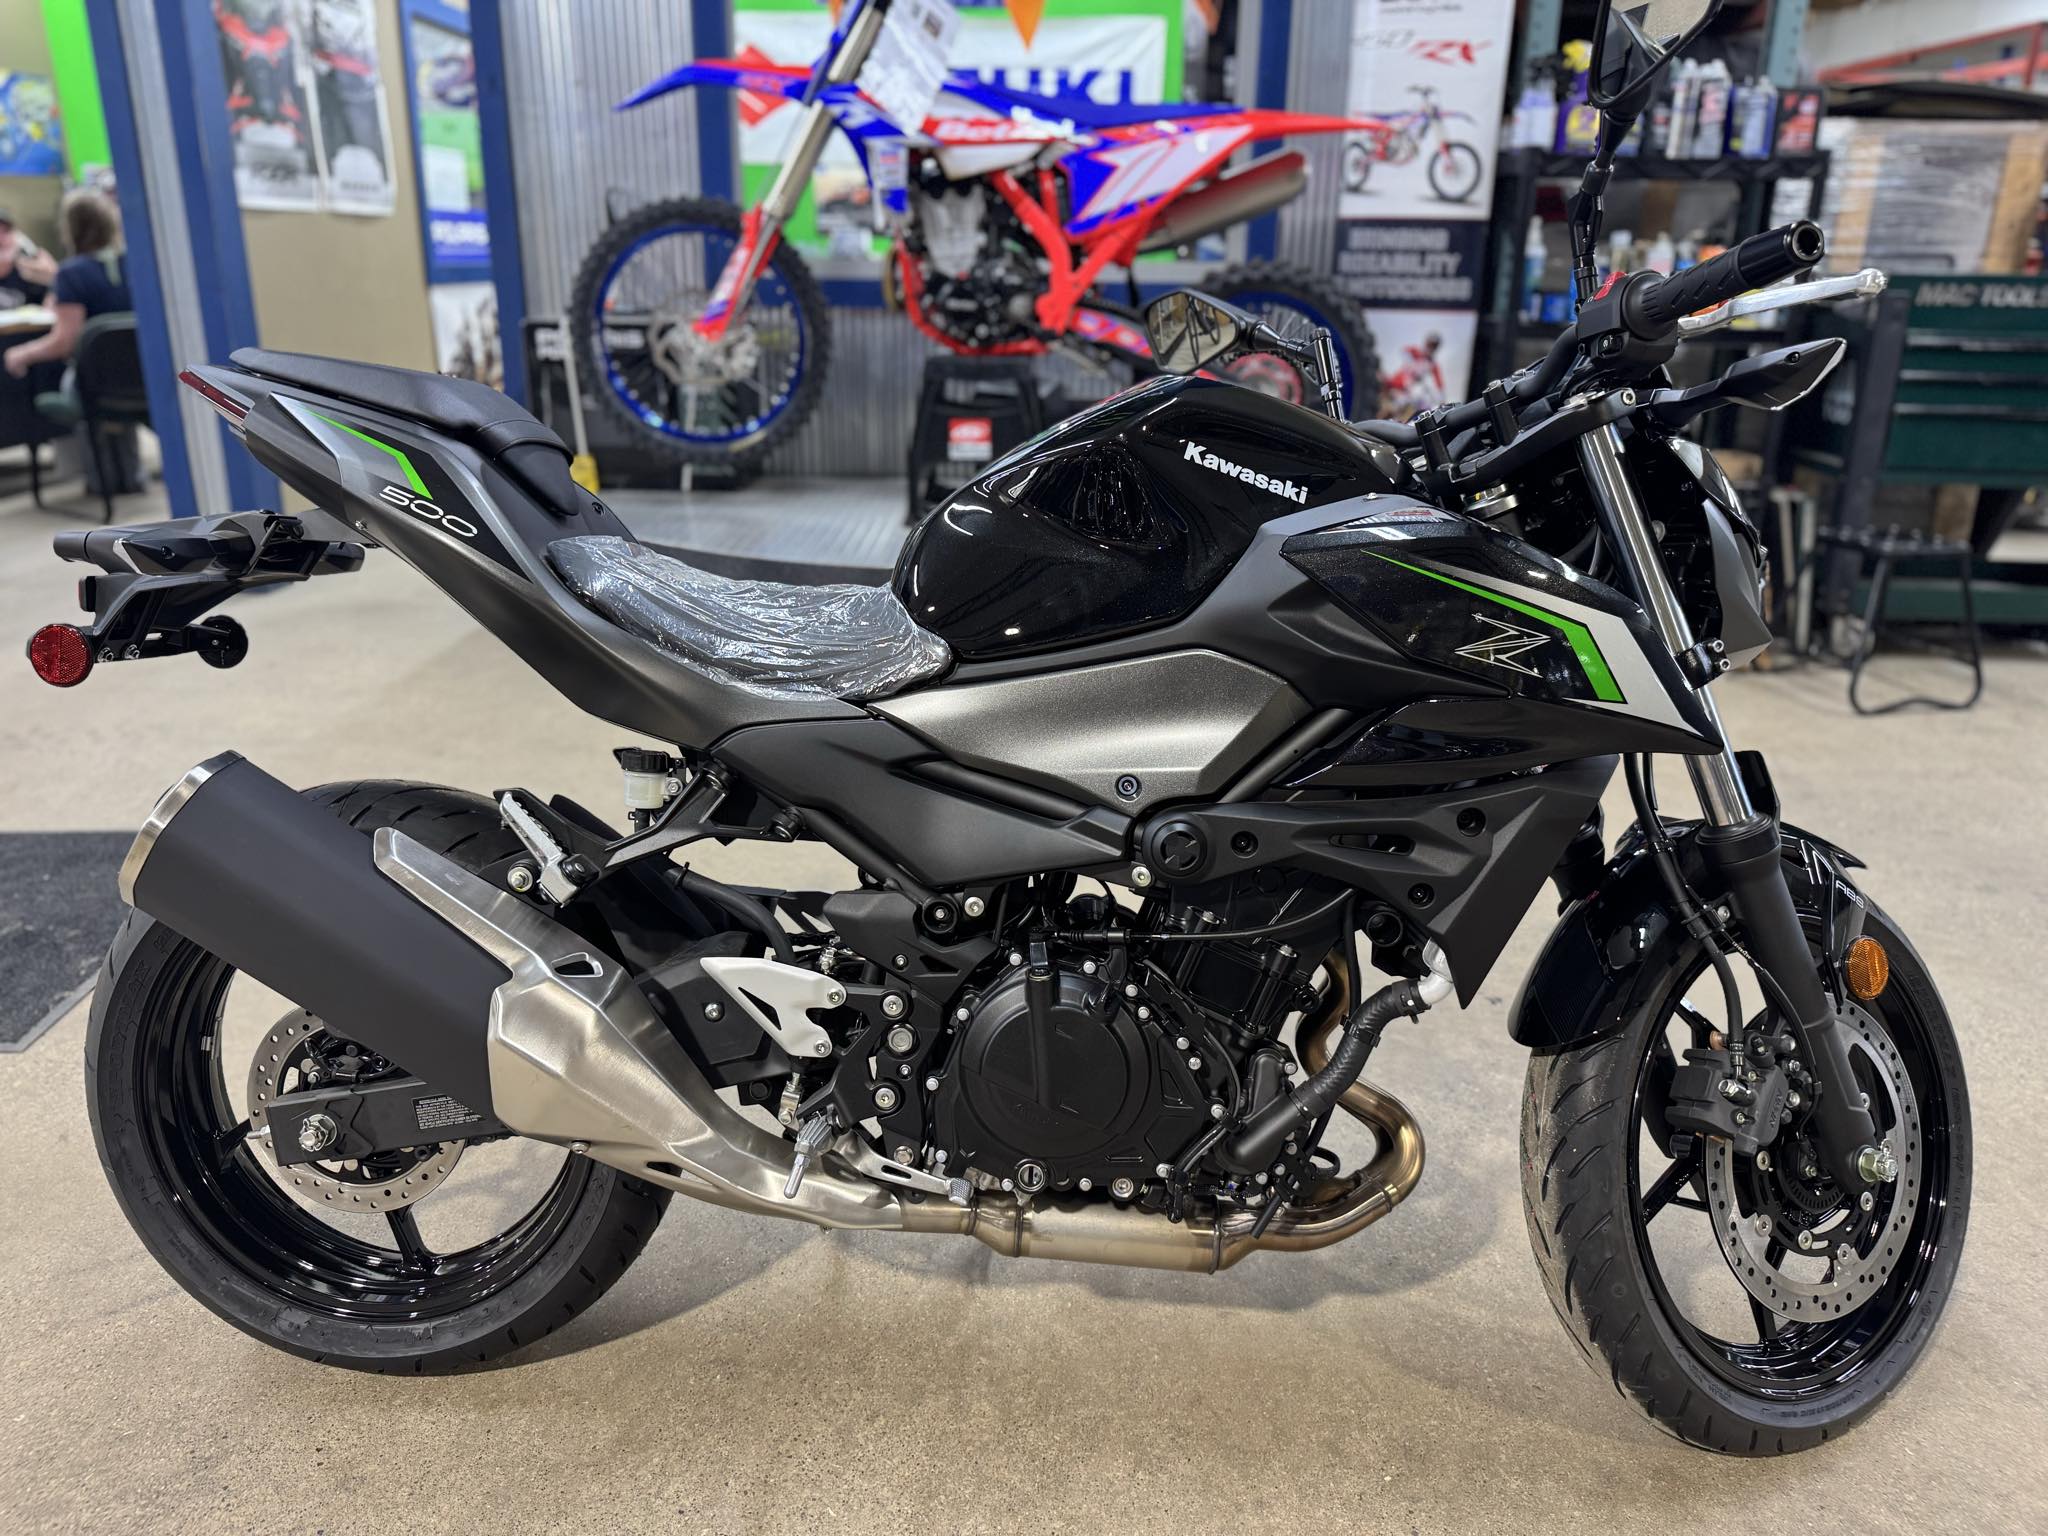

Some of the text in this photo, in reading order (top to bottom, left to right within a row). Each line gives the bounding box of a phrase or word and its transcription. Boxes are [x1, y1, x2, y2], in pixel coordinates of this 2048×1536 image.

[1183, 441, 1309, 505] Kawasaki
[379, 485, 478, 537] 500
[1835, 879, 1864, 909] ABS
